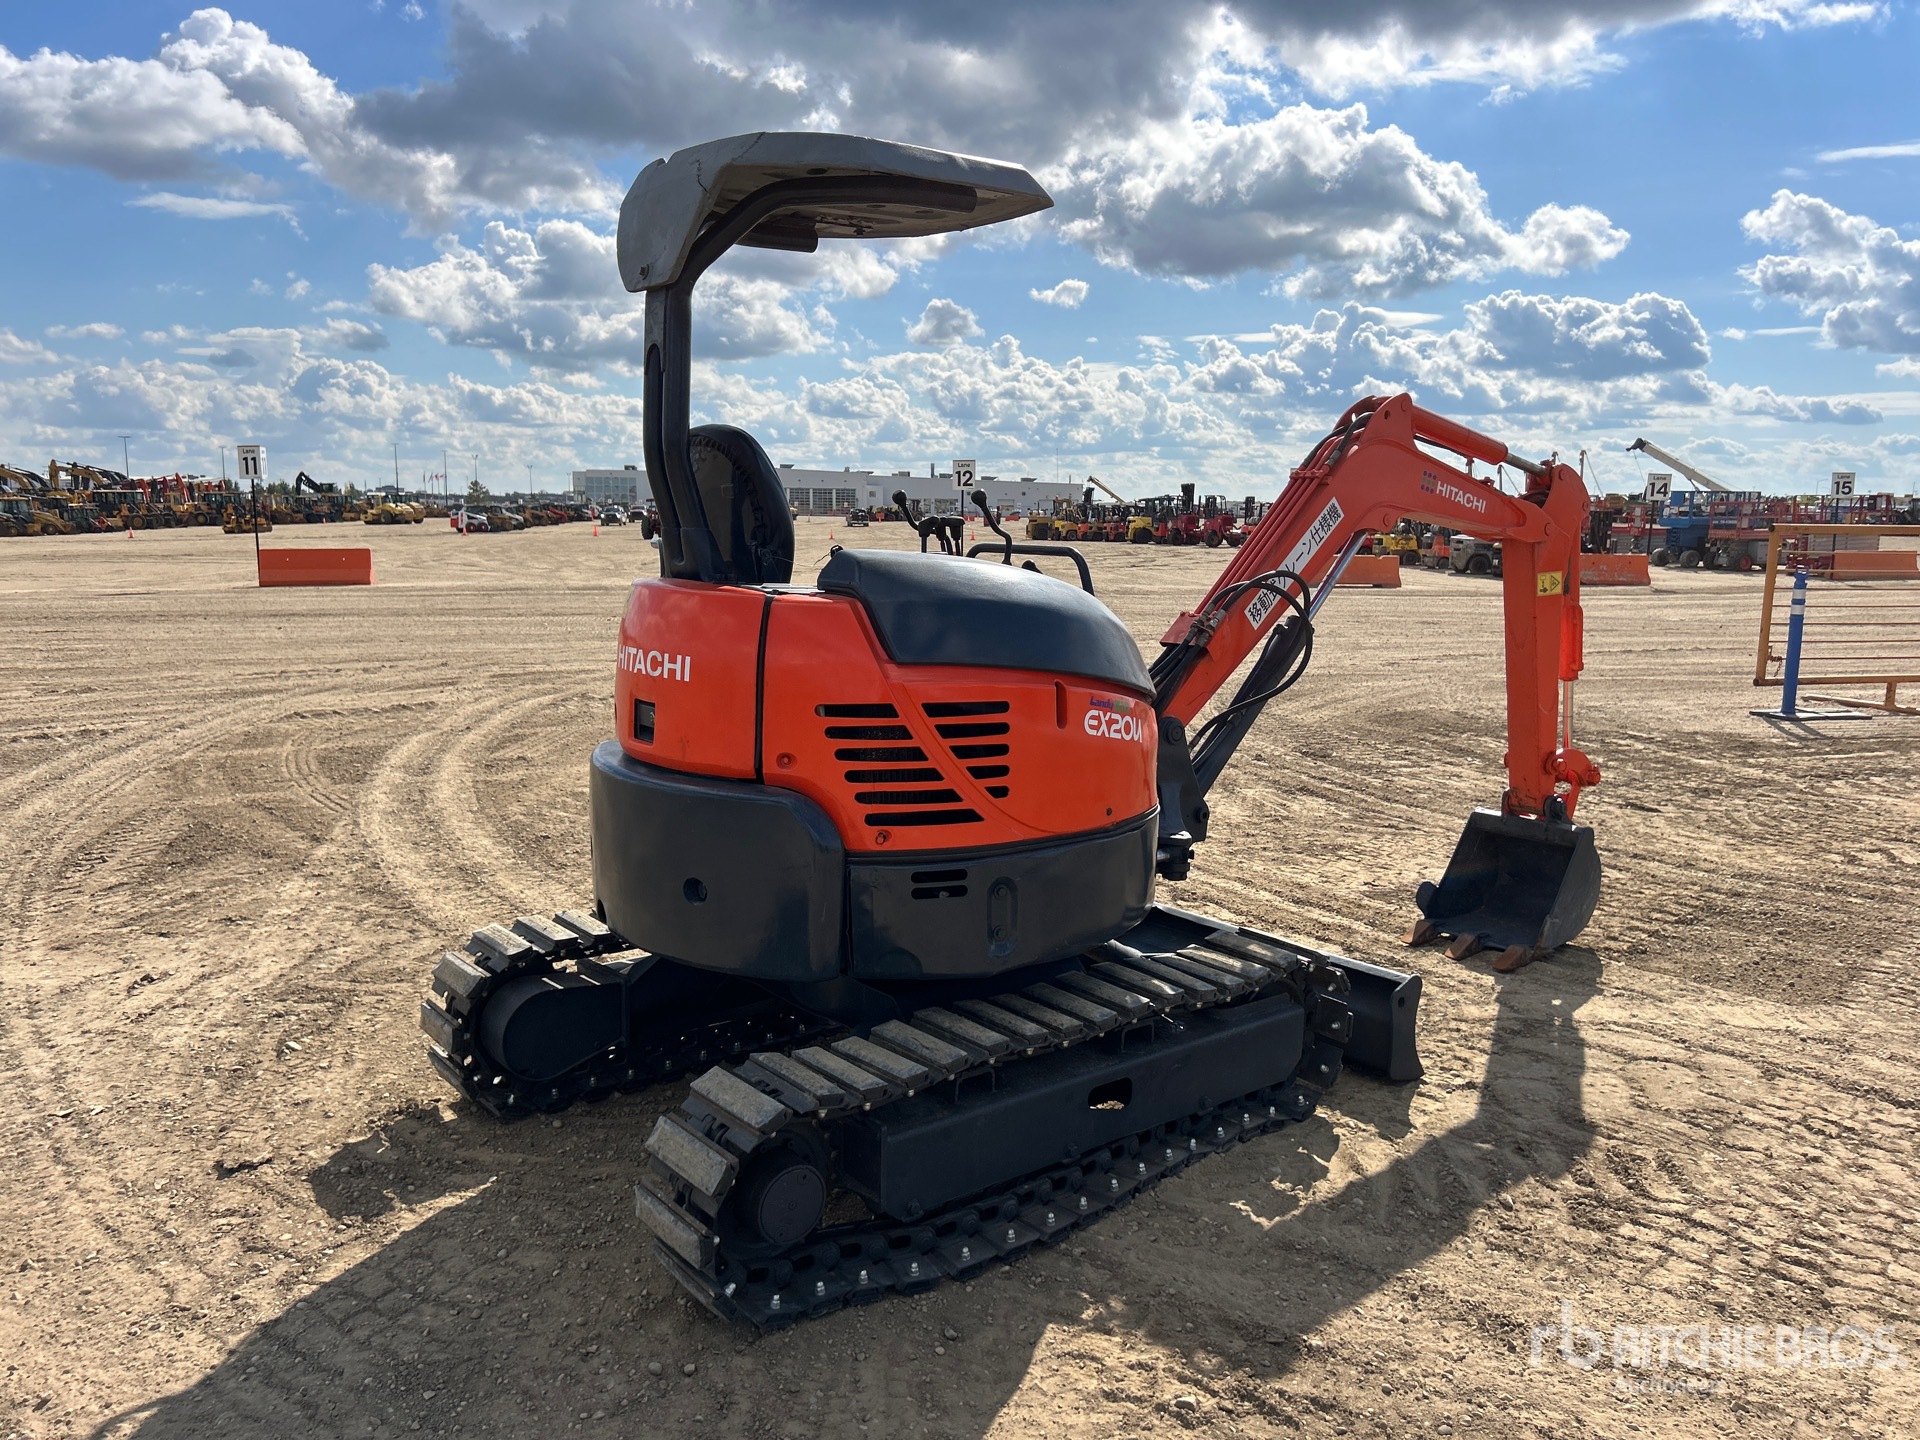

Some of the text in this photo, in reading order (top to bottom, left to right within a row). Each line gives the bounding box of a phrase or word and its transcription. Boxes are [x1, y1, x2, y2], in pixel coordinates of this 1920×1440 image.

[242, 456, 258, 475] 11
[955, 470, 974, 487] 12
[1436, 480, 1487, 514] HITACHI
[1649, 482, 1669, 498] 14
[1834, 480, 1853, 496] 15
[618, 643, 691, 682] HITACHI
